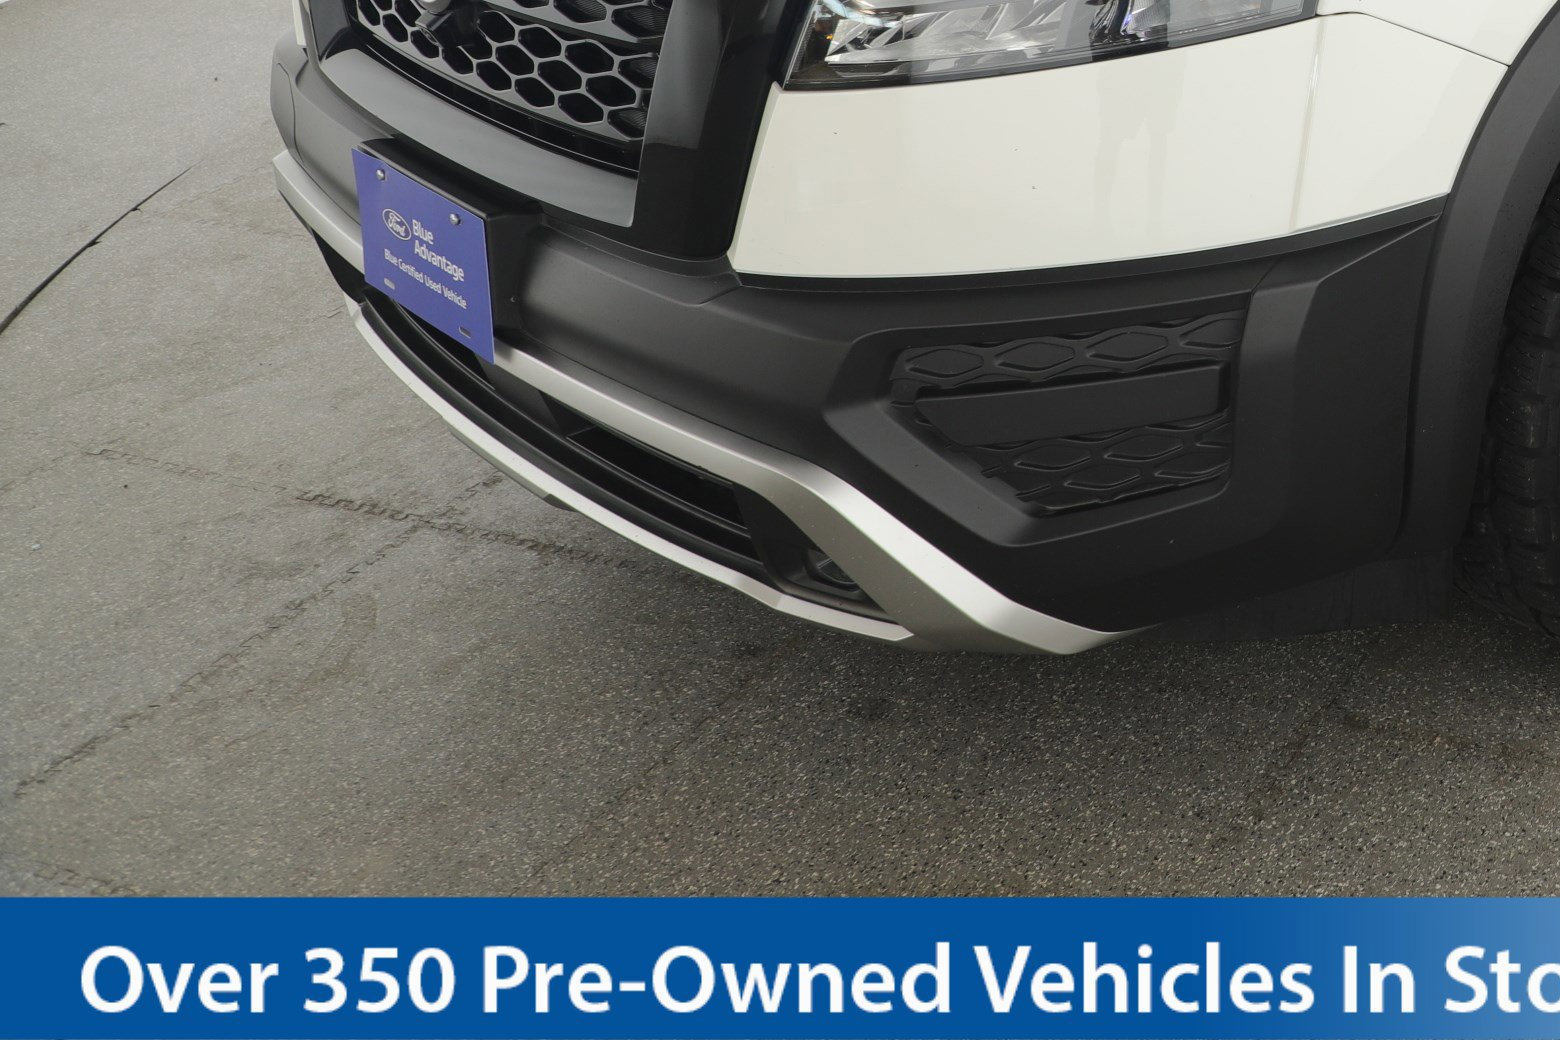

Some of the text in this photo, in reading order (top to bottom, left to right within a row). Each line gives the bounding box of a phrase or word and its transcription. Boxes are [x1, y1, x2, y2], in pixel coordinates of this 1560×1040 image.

[412, 219, 434, 245] Blue
[384, 249, 467, 310] Blue Certified Used Vehicle
[414, 240, 465, 282] Advantage
